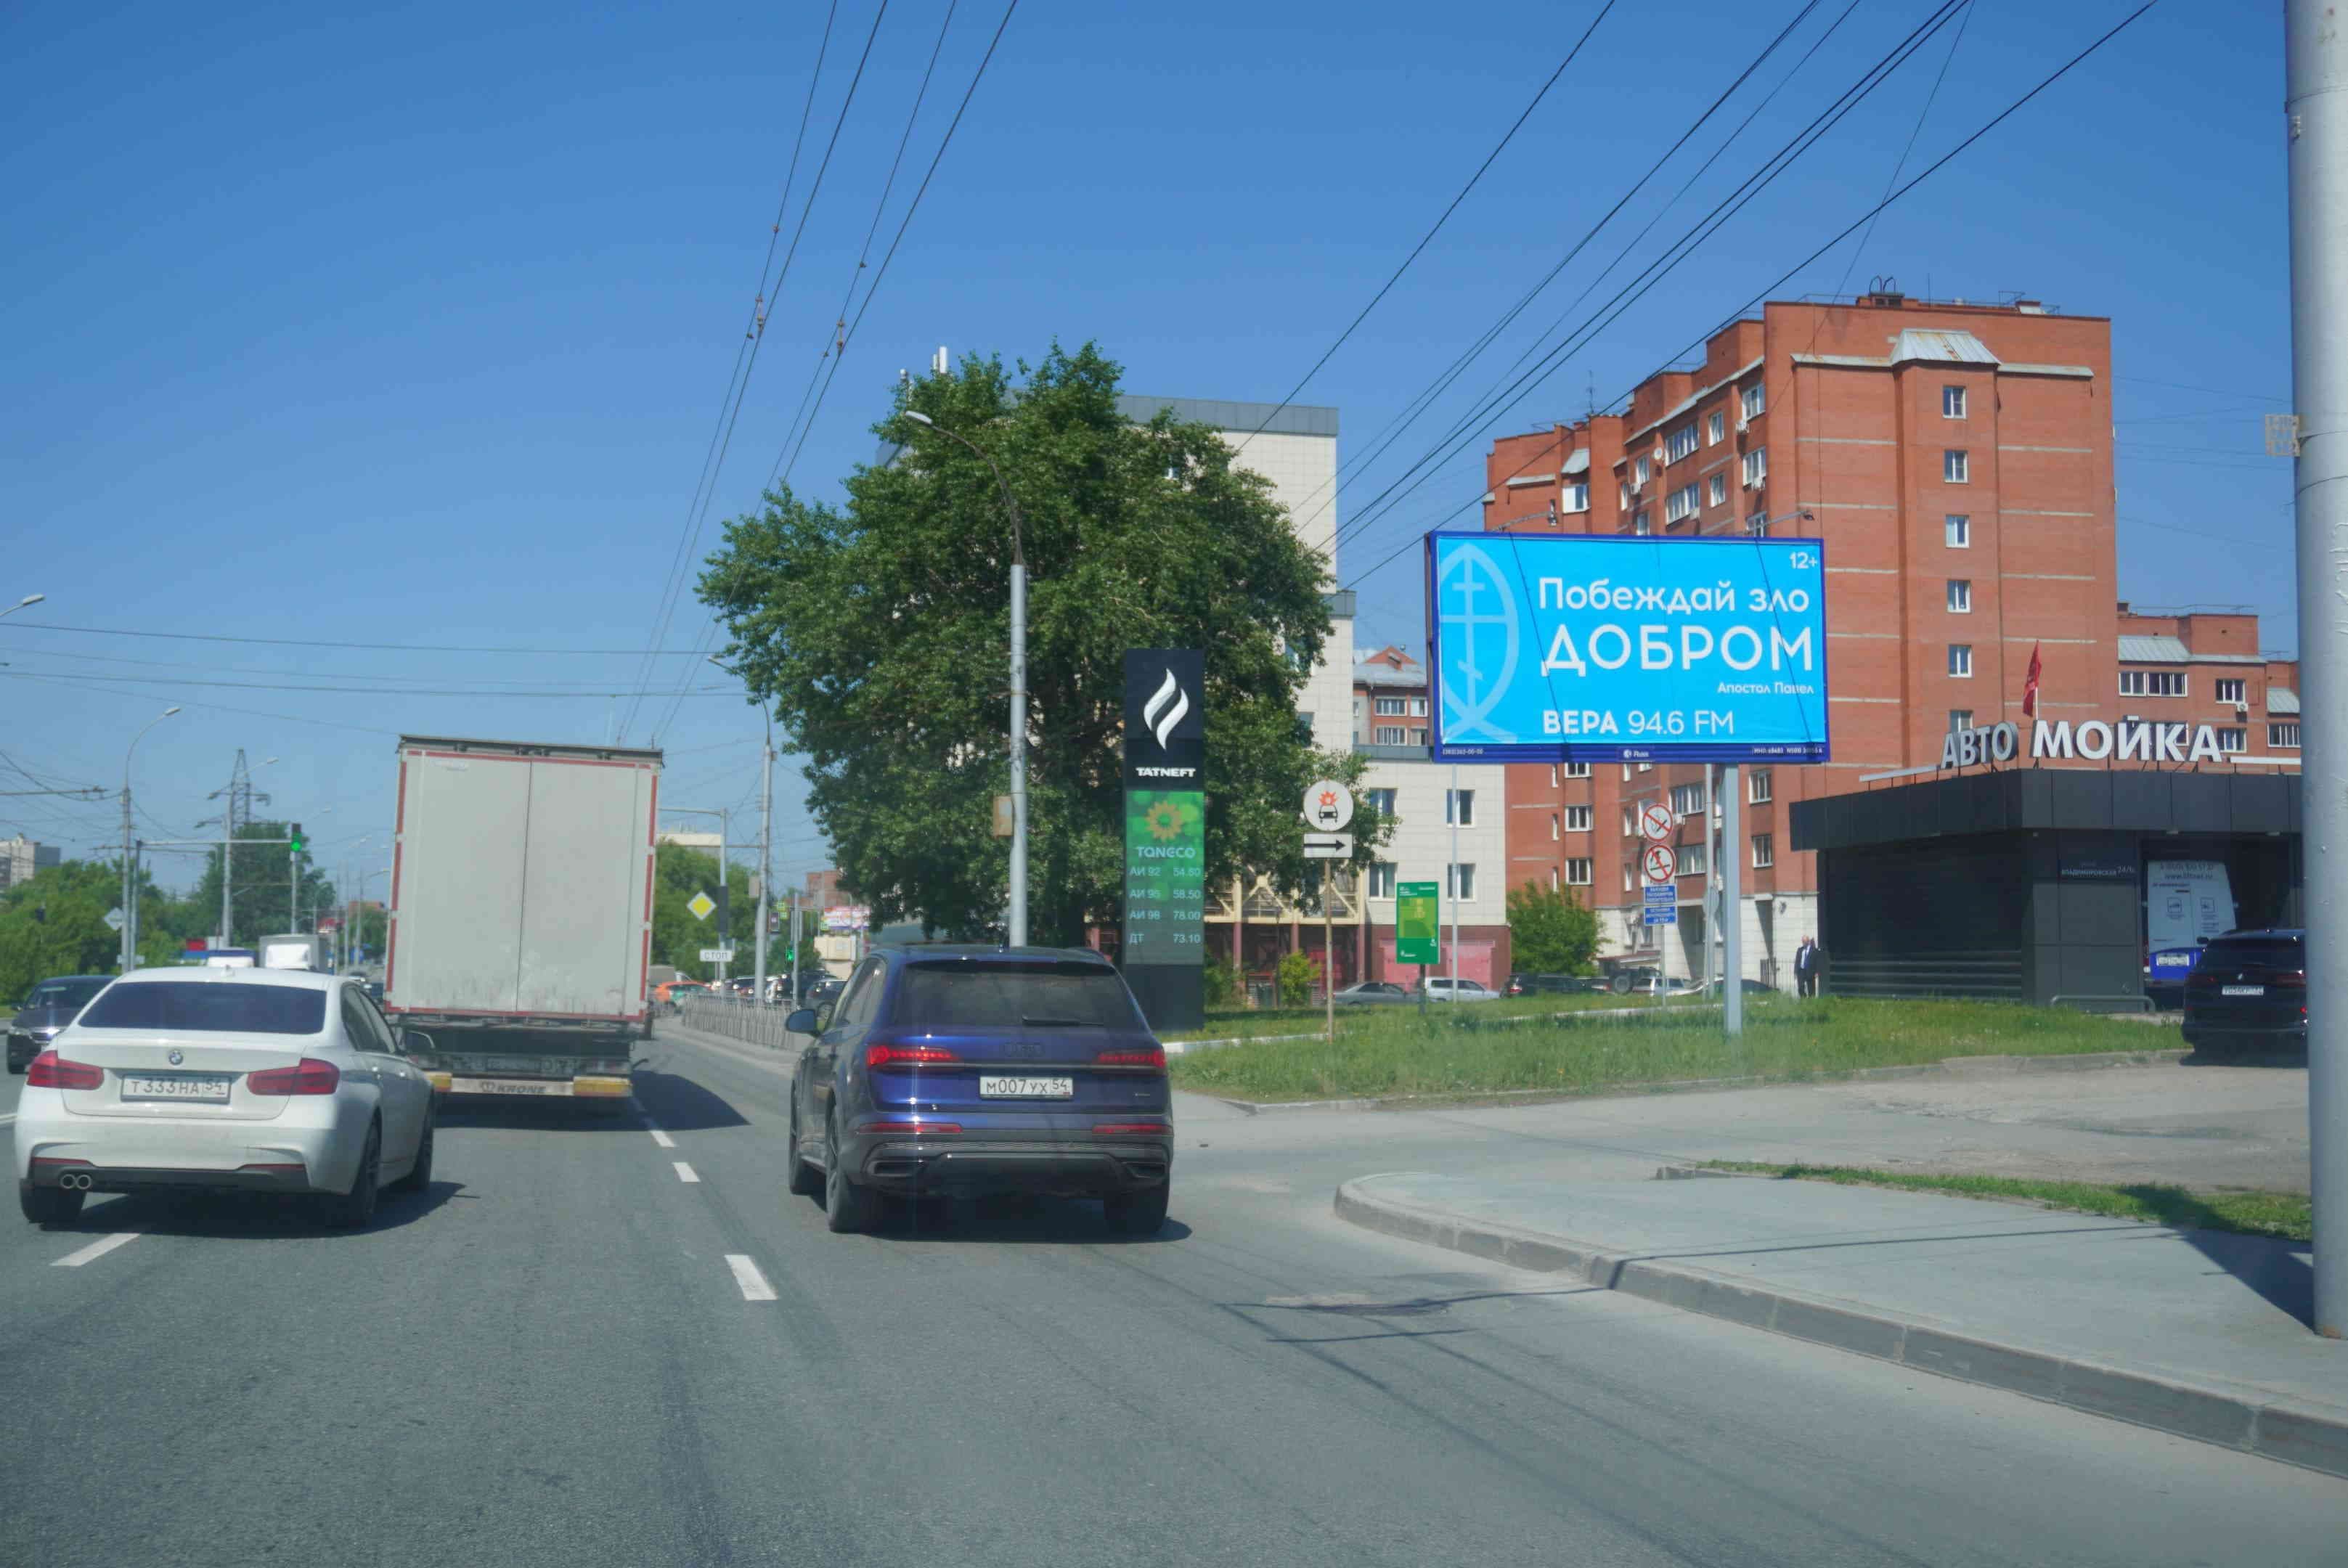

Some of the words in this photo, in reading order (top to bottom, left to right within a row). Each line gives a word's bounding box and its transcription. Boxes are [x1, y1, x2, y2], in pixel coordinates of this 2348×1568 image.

[1790, 552, 1818, 570] 12+
[1539, 577, 1736, 616] Побеждай
[1749, 588, 1810, 613] зло
[1540, 624, 1813, 677] ДОБРОМ
[1717, 682, 1771, 695] Апостол
[1774, 682, 1814, 695] Павел
[1544, 710, 1619, 735] ВЕРА
[1627, 710, 1685, 735] 94.6
[1695, 711, 1734, 735] FM
[1941, 722, 2018, 769] АВТО
[2033, 715, 2222, 762] МОЙКА
[1136, 766, 1197, 778] TATNEFT
[1129, 867, 1145, 877] АИ
[1147, 867, 1162, 877] 92
[1129, 889, 1145, 899] АИ
[1129, 911, 1145, 920] АИ
[1129, 934, 1144, 944] ДТ
[1173, 934, 1201, 944] 73.10
[497, 1085, 546, 1095] KRONE
[986, 1079, 1048, 1093] М007УХ
[1052, 1079, 1068, 1091] 54
